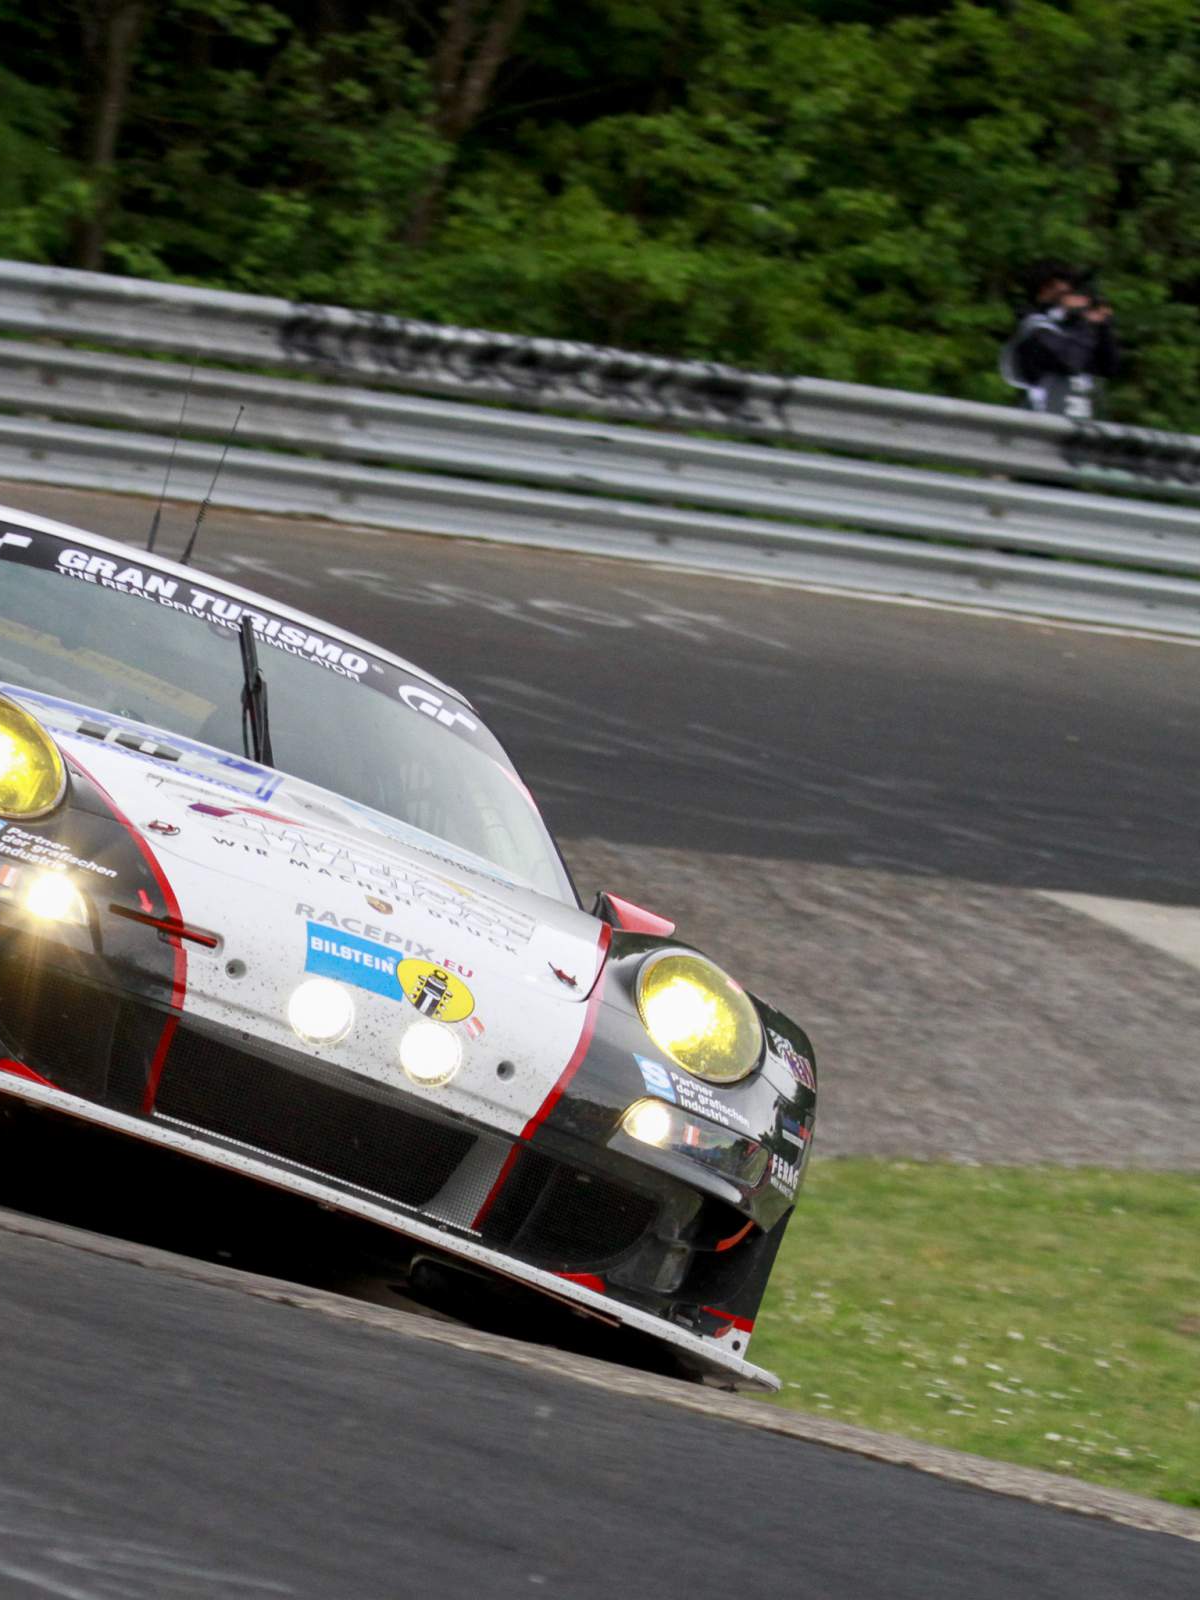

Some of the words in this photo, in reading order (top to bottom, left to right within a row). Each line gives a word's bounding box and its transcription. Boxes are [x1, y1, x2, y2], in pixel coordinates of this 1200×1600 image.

[54, 564, 98, 583] THE
[101, 576, 156, 601] REAL
[159, 596, 242, 632] DRIVING
[57, 549, 178, 598] GRAN
[190, 588, 369, 675] TURISMO
[1, 834, 31, 847] der
[31, 843, 119, 878] grafischen
[6, 827, 70, 851] Partner
[212, 835, 269, 858] WIR
[294, 902, 474, 979] RACEPIX.EU
[310, 935, 396, 976] BILSTEIN
[670, 1071, 714, 1098] Partner
[676, 1083, 696, 1099] der
[697, 1093, 750, 1129] grafischen
[771, 1152, 799, 1190] FERAG
